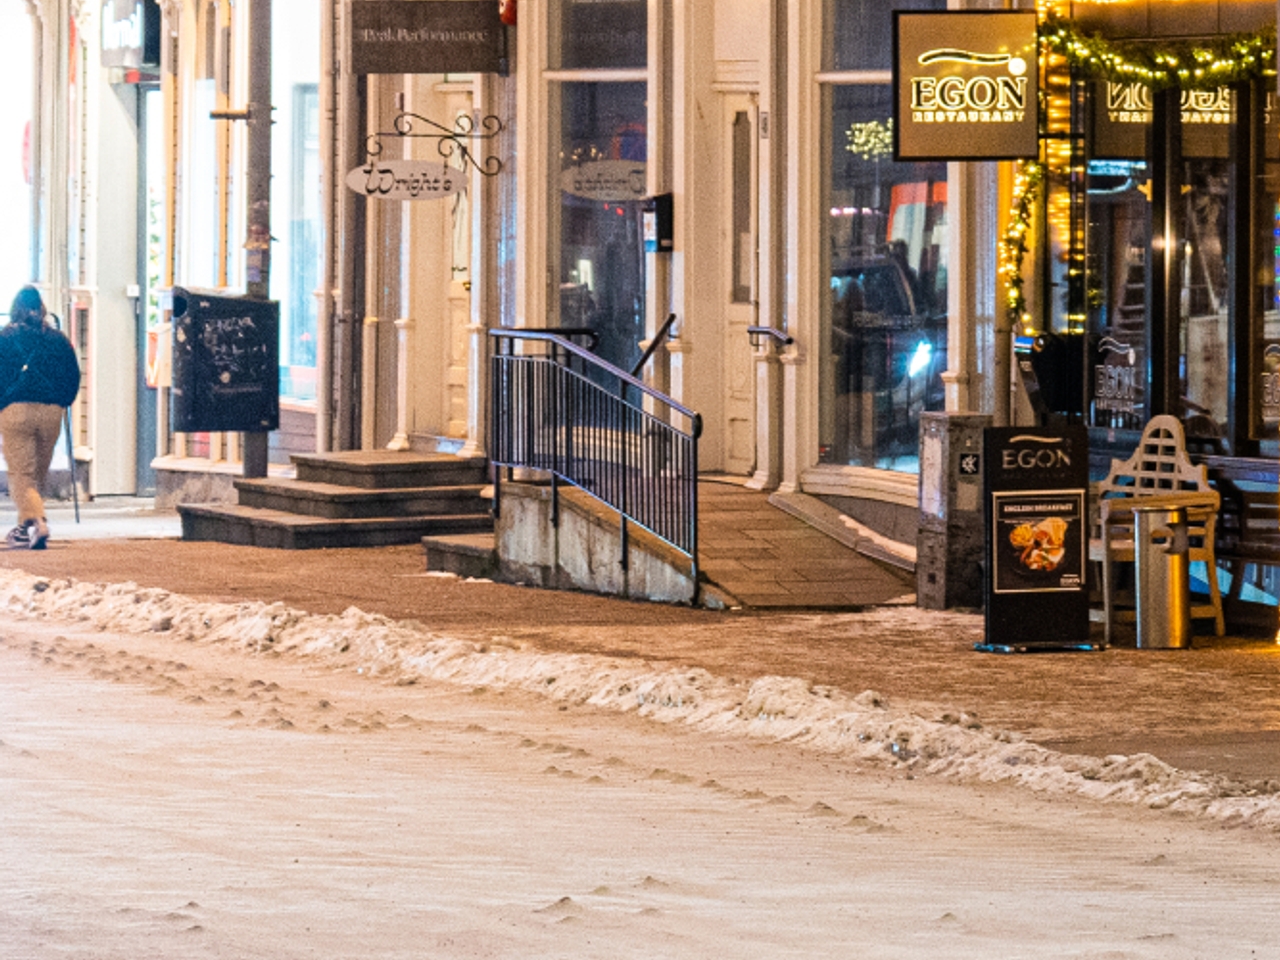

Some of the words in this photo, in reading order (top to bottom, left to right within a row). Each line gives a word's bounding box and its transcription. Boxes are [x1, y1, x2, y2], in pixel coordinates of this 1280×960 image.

[910, 76, 1028, 110] EGON
[912, 111, 1025, 123] RESTAURANT
[1002, 449, 1071, 469] EGON
